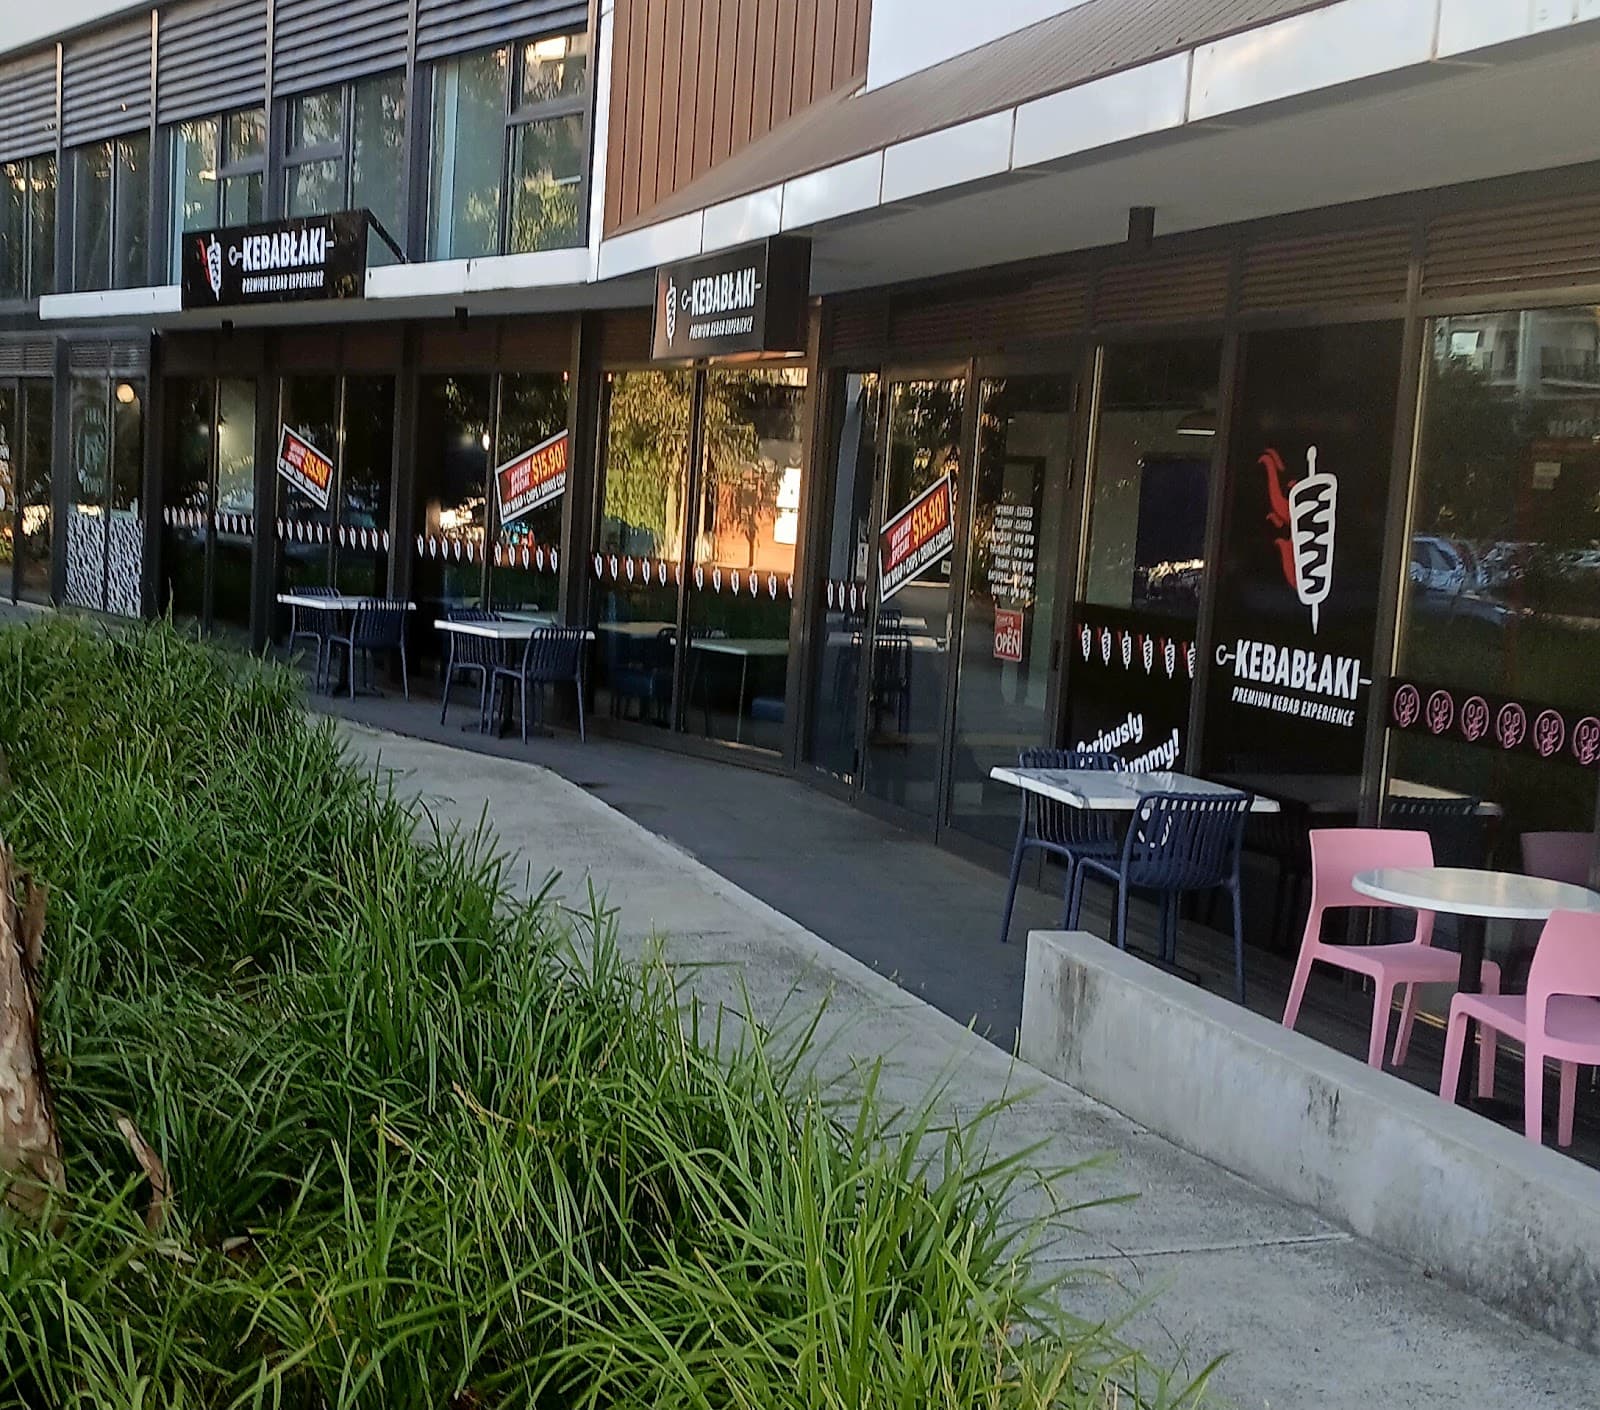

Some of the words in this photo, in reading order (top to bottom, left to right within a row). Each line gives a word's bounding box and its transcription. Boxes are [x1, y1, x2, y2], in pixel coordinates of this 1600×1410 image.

[912, 490, 946, 547] $15.90!
[995, 632, 1020, 656] OPEN
[1231, 686, 1272, 708] PREMIUM
[1272, 694, 1300, 715] KEBAB
[1300, 701, 1356, 727] EXPERIENCE
